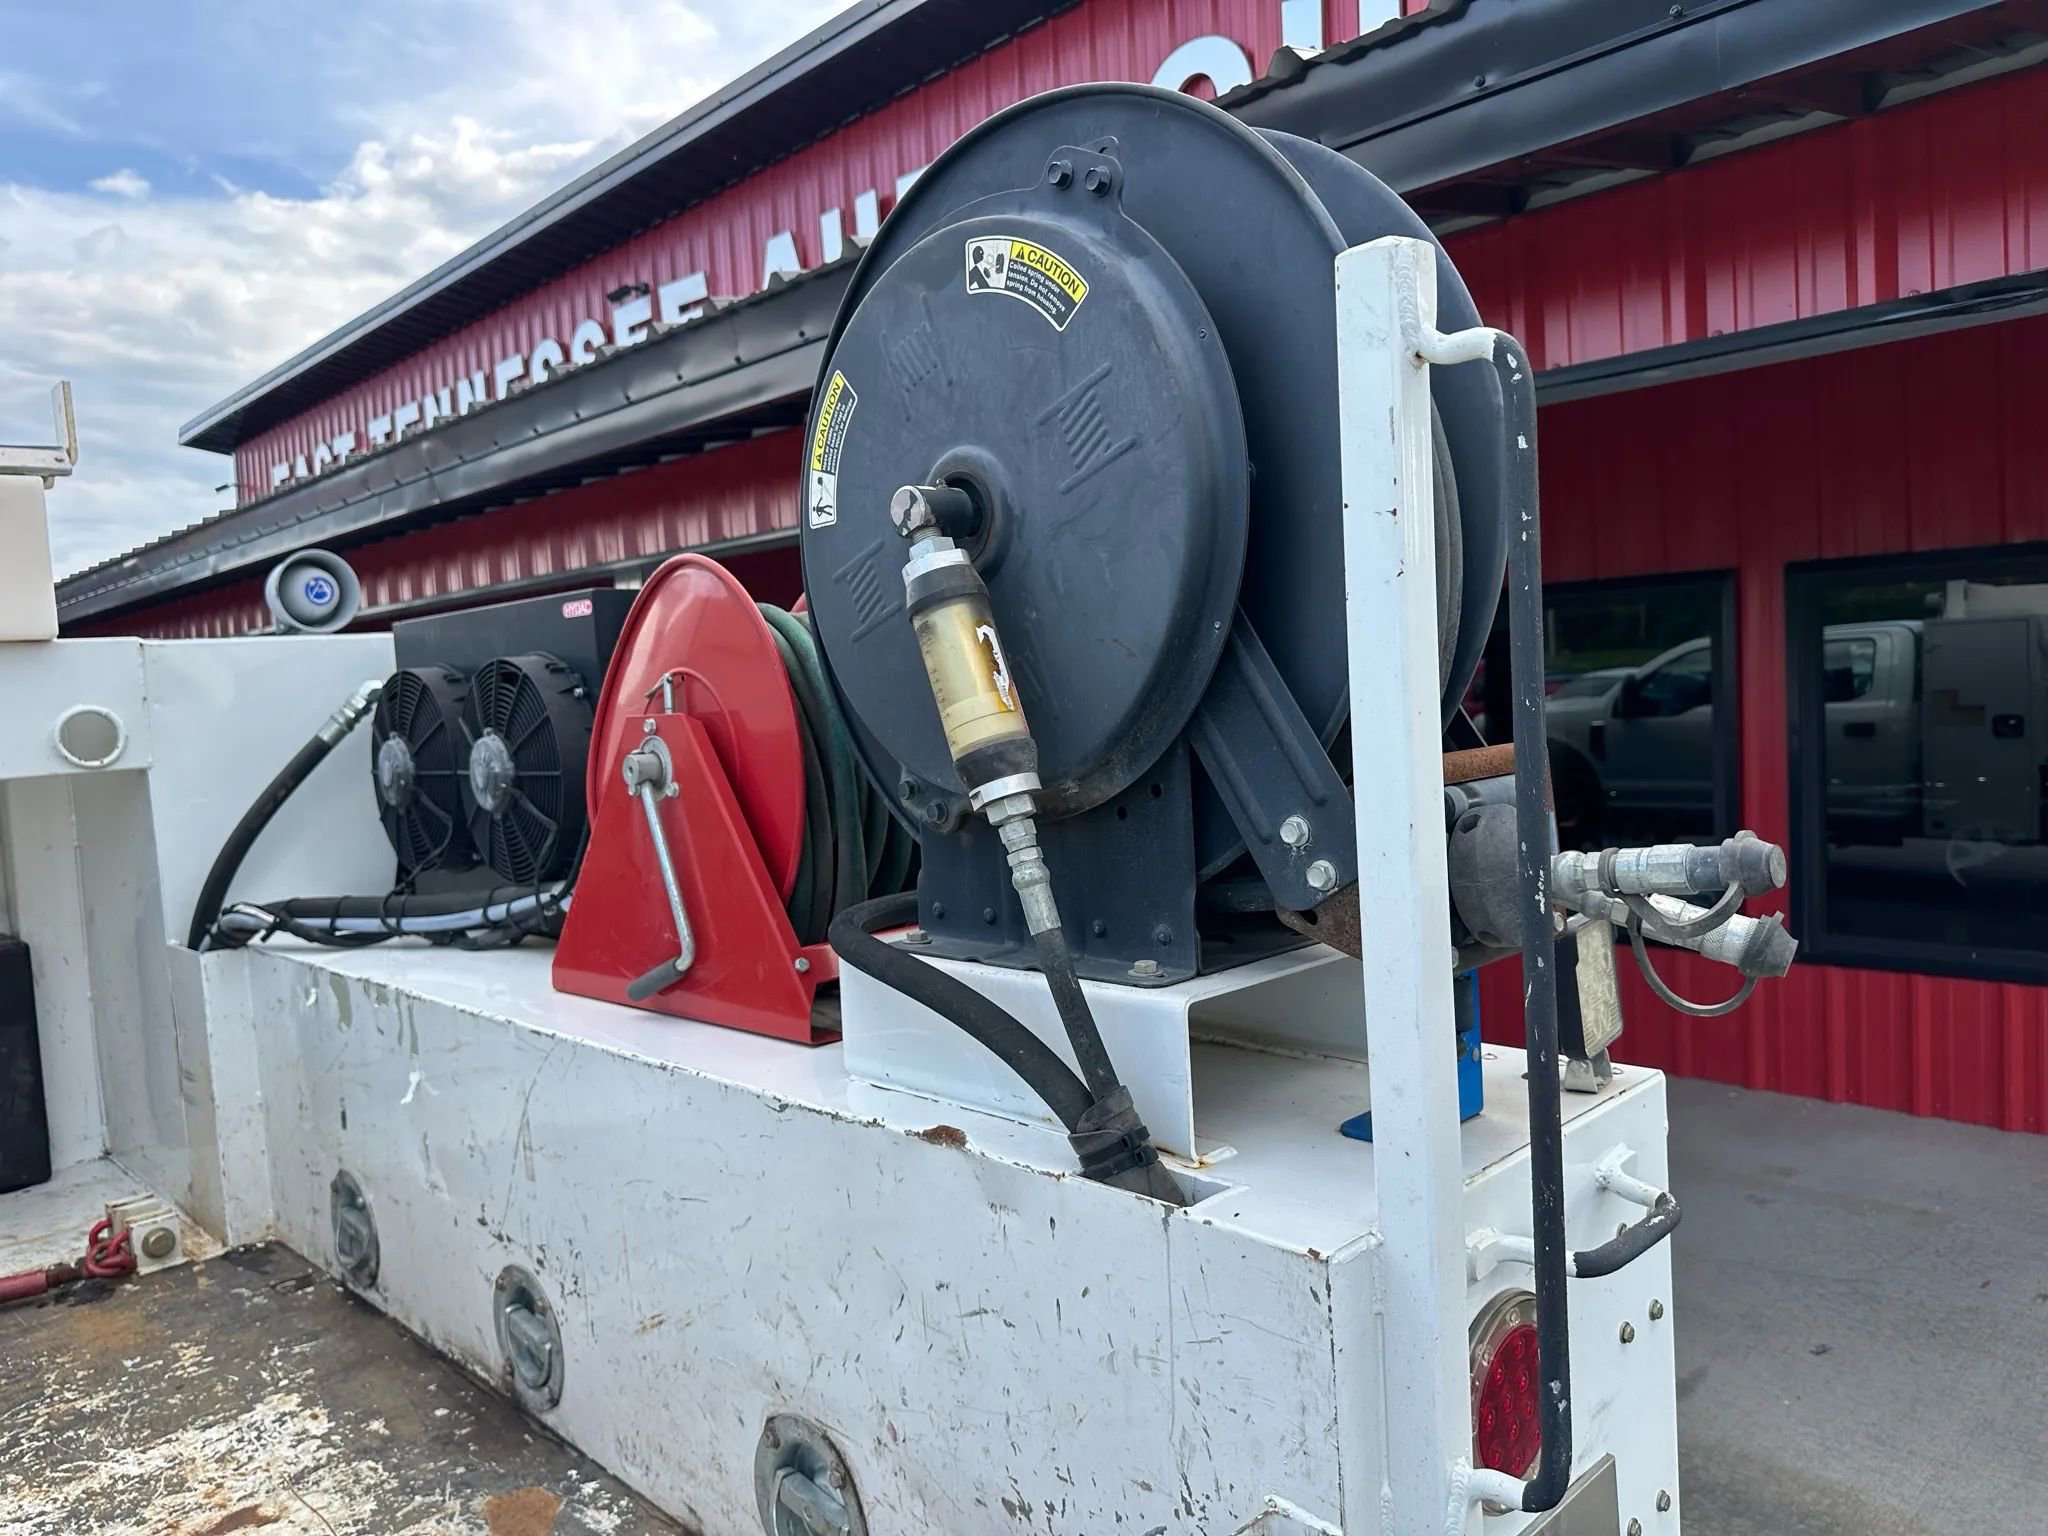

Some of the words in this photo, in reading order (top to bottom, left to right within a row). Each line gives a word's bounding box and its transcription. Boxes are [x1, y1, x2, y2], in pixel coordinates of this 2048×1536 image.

[1008, 271, 1029, 283] tension.
[1030, 278, 1039, 288] Do
[1038, 285, 1049, 295] not
[1047, 292, 1066, 312] remove
[1009, 261, 1027, 272] Coiled
[1027, 268, 1045, 284] spring
[1045, 279, 1061, 294] under
[1027, 250, 1080, 295] CAUTION
[1006, 280, 1023, 291] spring
[1024, 284, 1037, 297] from
[1037, 292, 1057, 314] housing.
[368, 271, 708, 443] TENNESSEE
[817, 382, 841, 450] CAUTION
